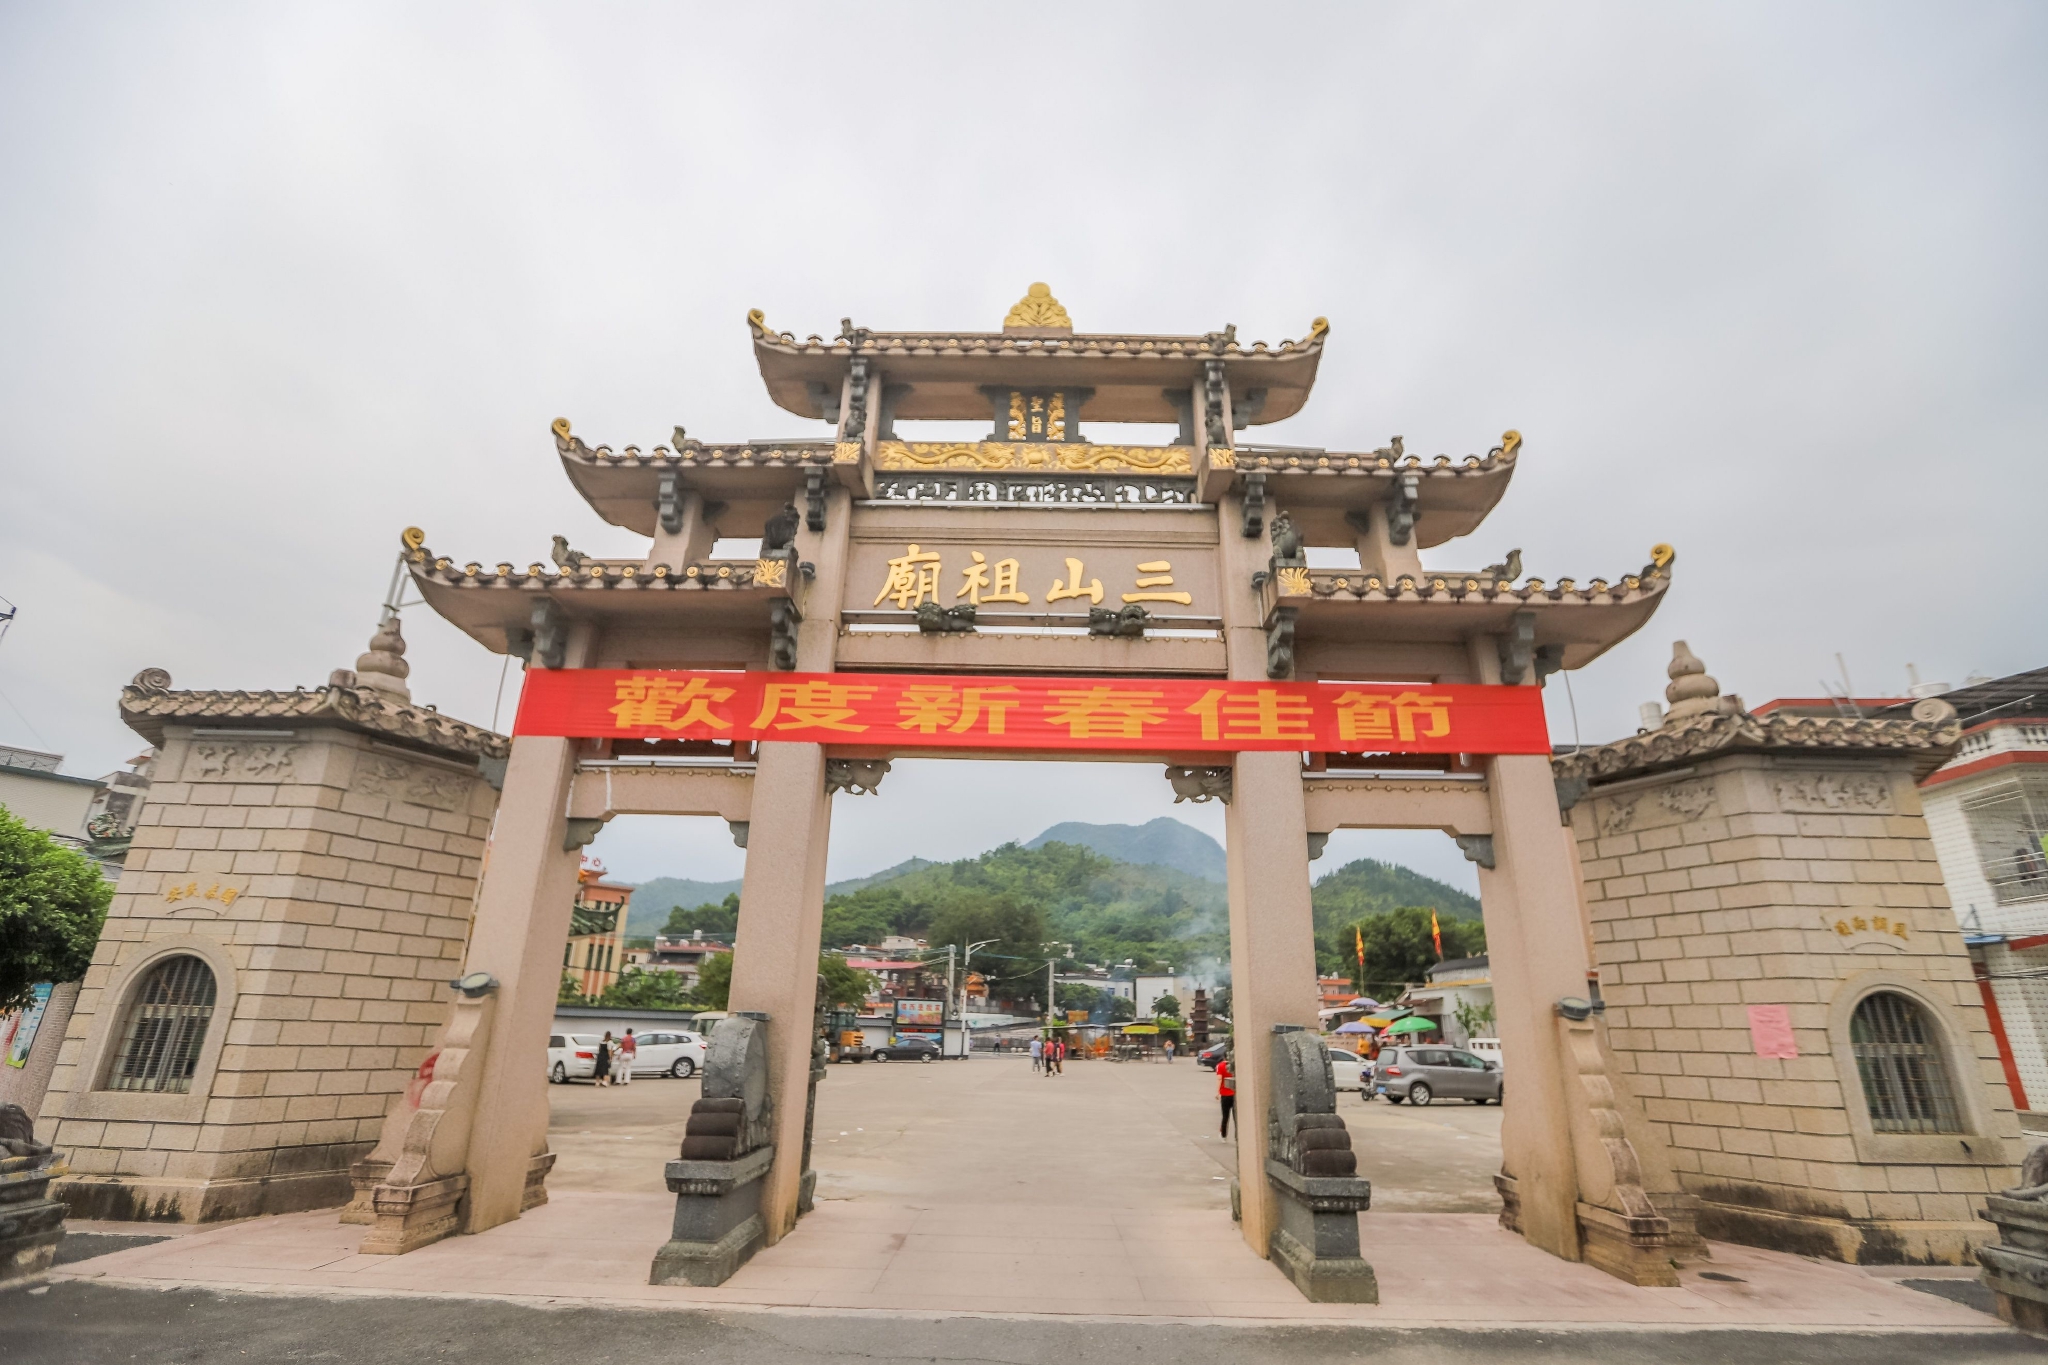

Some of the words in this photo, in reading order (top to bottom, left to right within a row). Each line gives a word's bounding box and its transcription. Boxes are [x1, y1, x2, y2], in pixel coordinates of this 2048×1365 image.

[608, 677, 1453, 742] 歡度新春佳節
